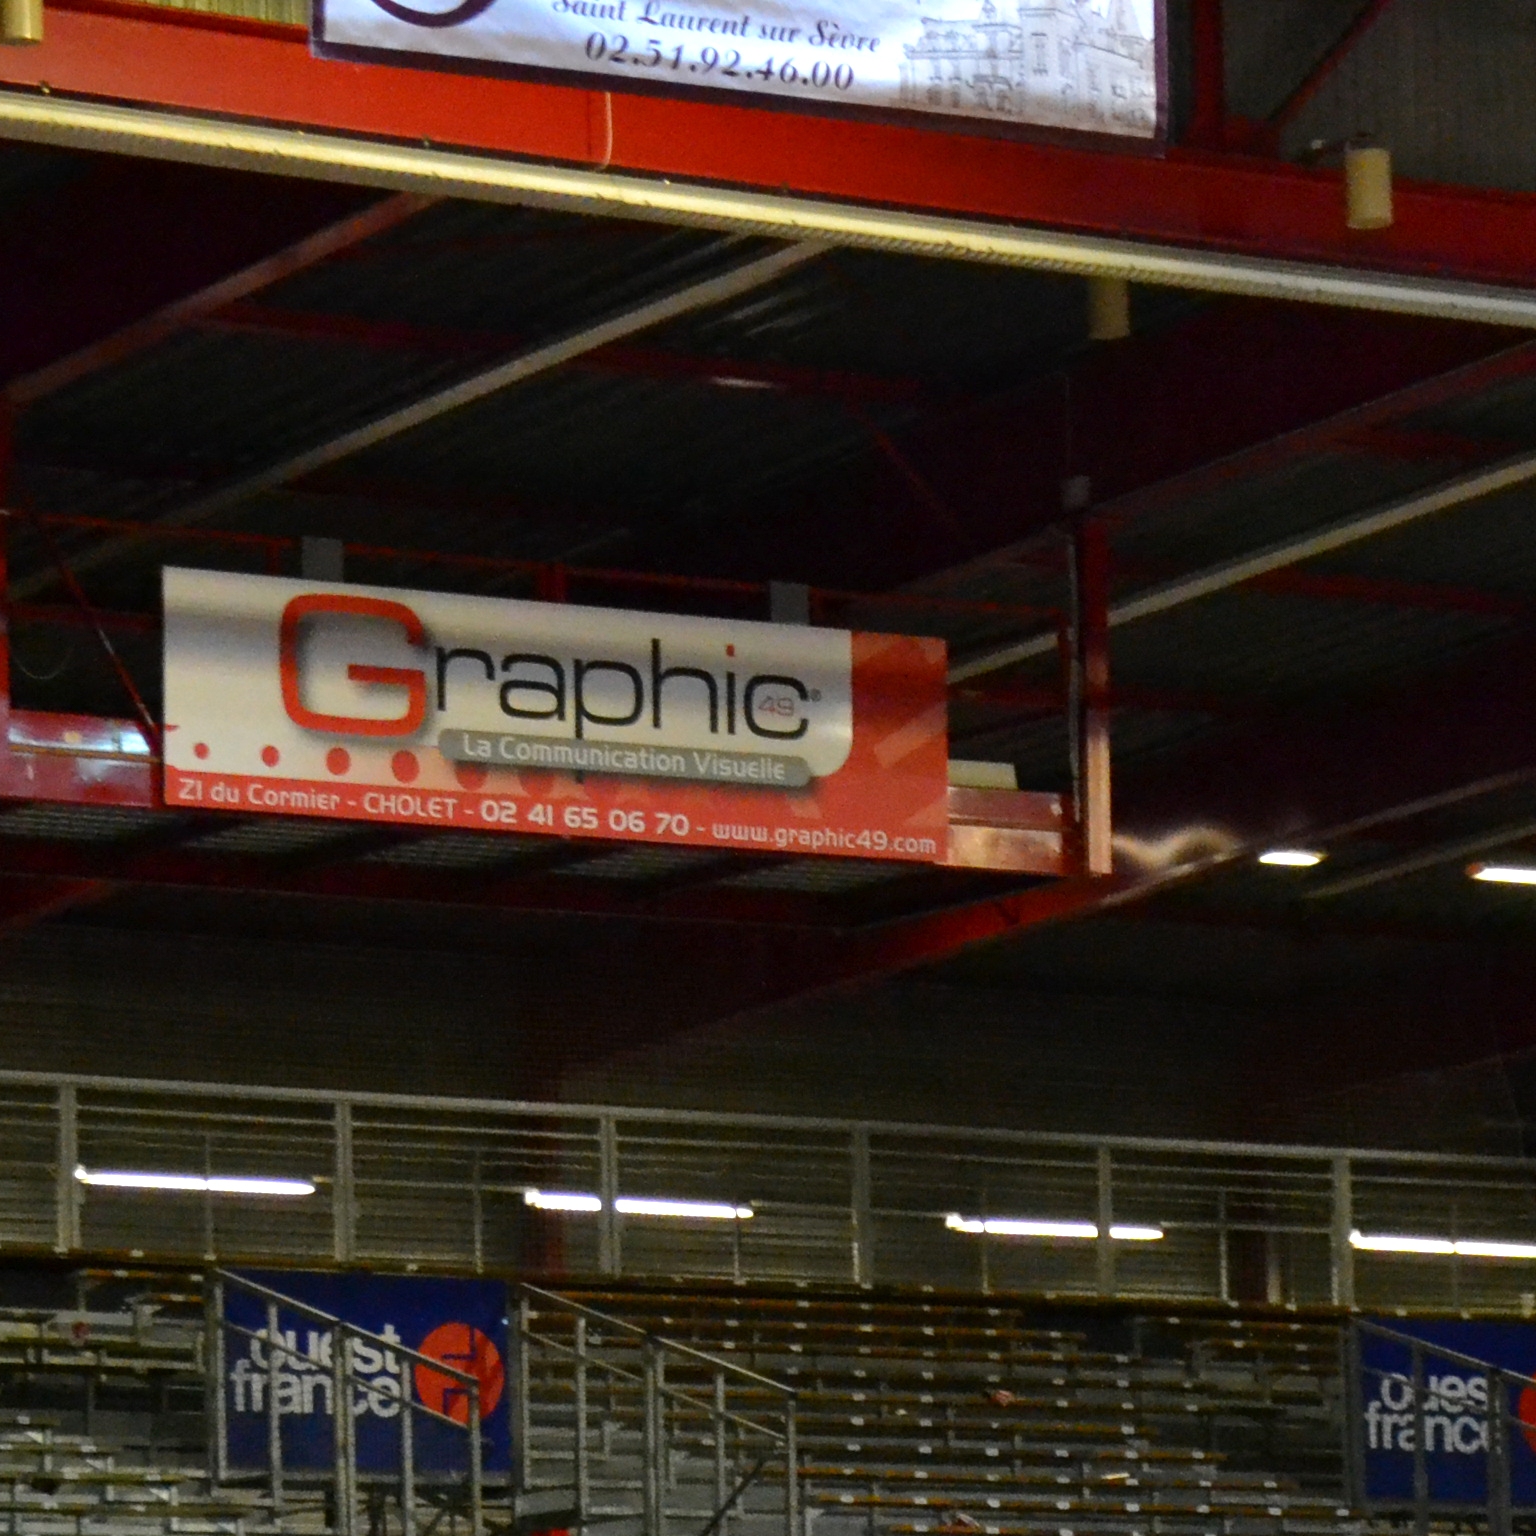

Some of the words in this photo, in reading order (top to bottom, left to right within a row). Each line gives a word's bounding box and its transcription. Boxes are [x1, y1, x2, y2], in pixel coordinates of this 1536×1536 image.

[636, 2, 749, 38] Laurent
[757, 21, 801, 43] sur
[808, 20, 880, 52] Sèvre
[584, 31, 855, 91] 02.51.92.46.00
[278, 593, 809, 744] Graphic
[463, 733, 492, 758] La
[498, 737, 686, 773] Communication
[692, 750, 786, 781] Visuelle
[178, 777, 203, 801] ZI
[210, 781, 240, 803] du
[246, 783, 341, 811] Cormier
[363, 792, 458, 820] CHOLET
[480, 799, 518, 824] 02
[527, 803, 554, 827] 41
[563, 806, 599, 830] 65
[608, 808, 647, 833] 06
[654, 811, 690, 837] 70
[711, 821, 937, 855] www.graphic49.com
